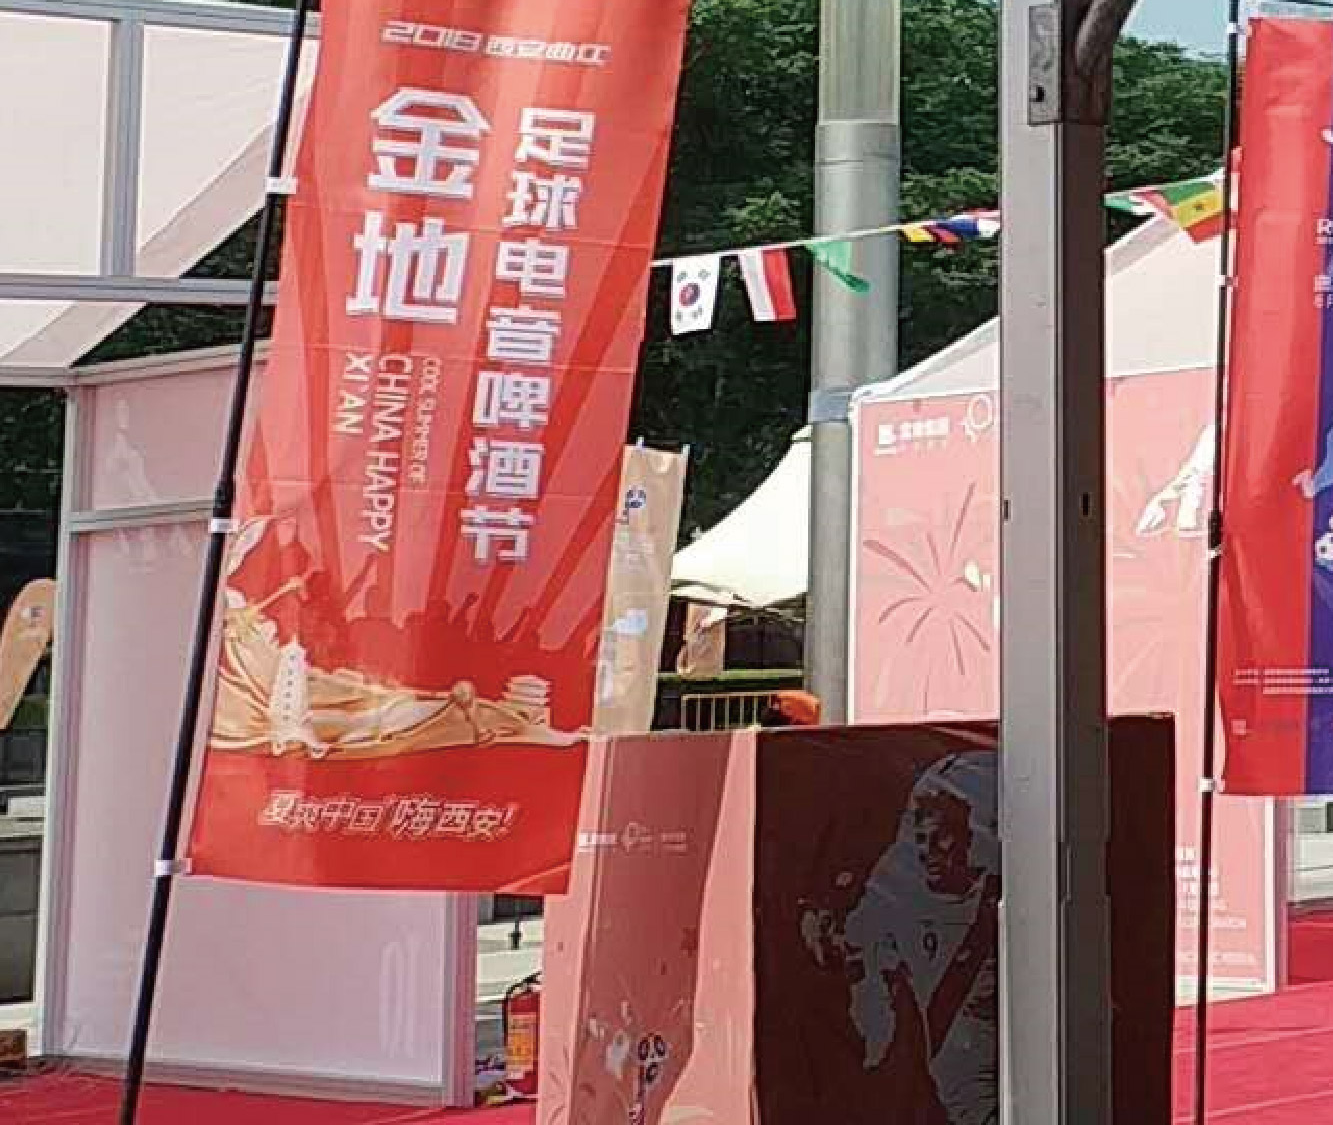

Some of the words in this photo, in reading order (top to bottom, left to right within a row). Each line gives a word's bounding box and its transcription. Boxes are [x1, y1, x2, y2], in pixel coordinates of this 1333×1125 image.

[346, 86, 492, 326] 金地
[368, 353, 415, 444] CHINA
[460, 105, 596, 565] 足球电音啤酒节
[356, 449, 401, 553] HAPPY
